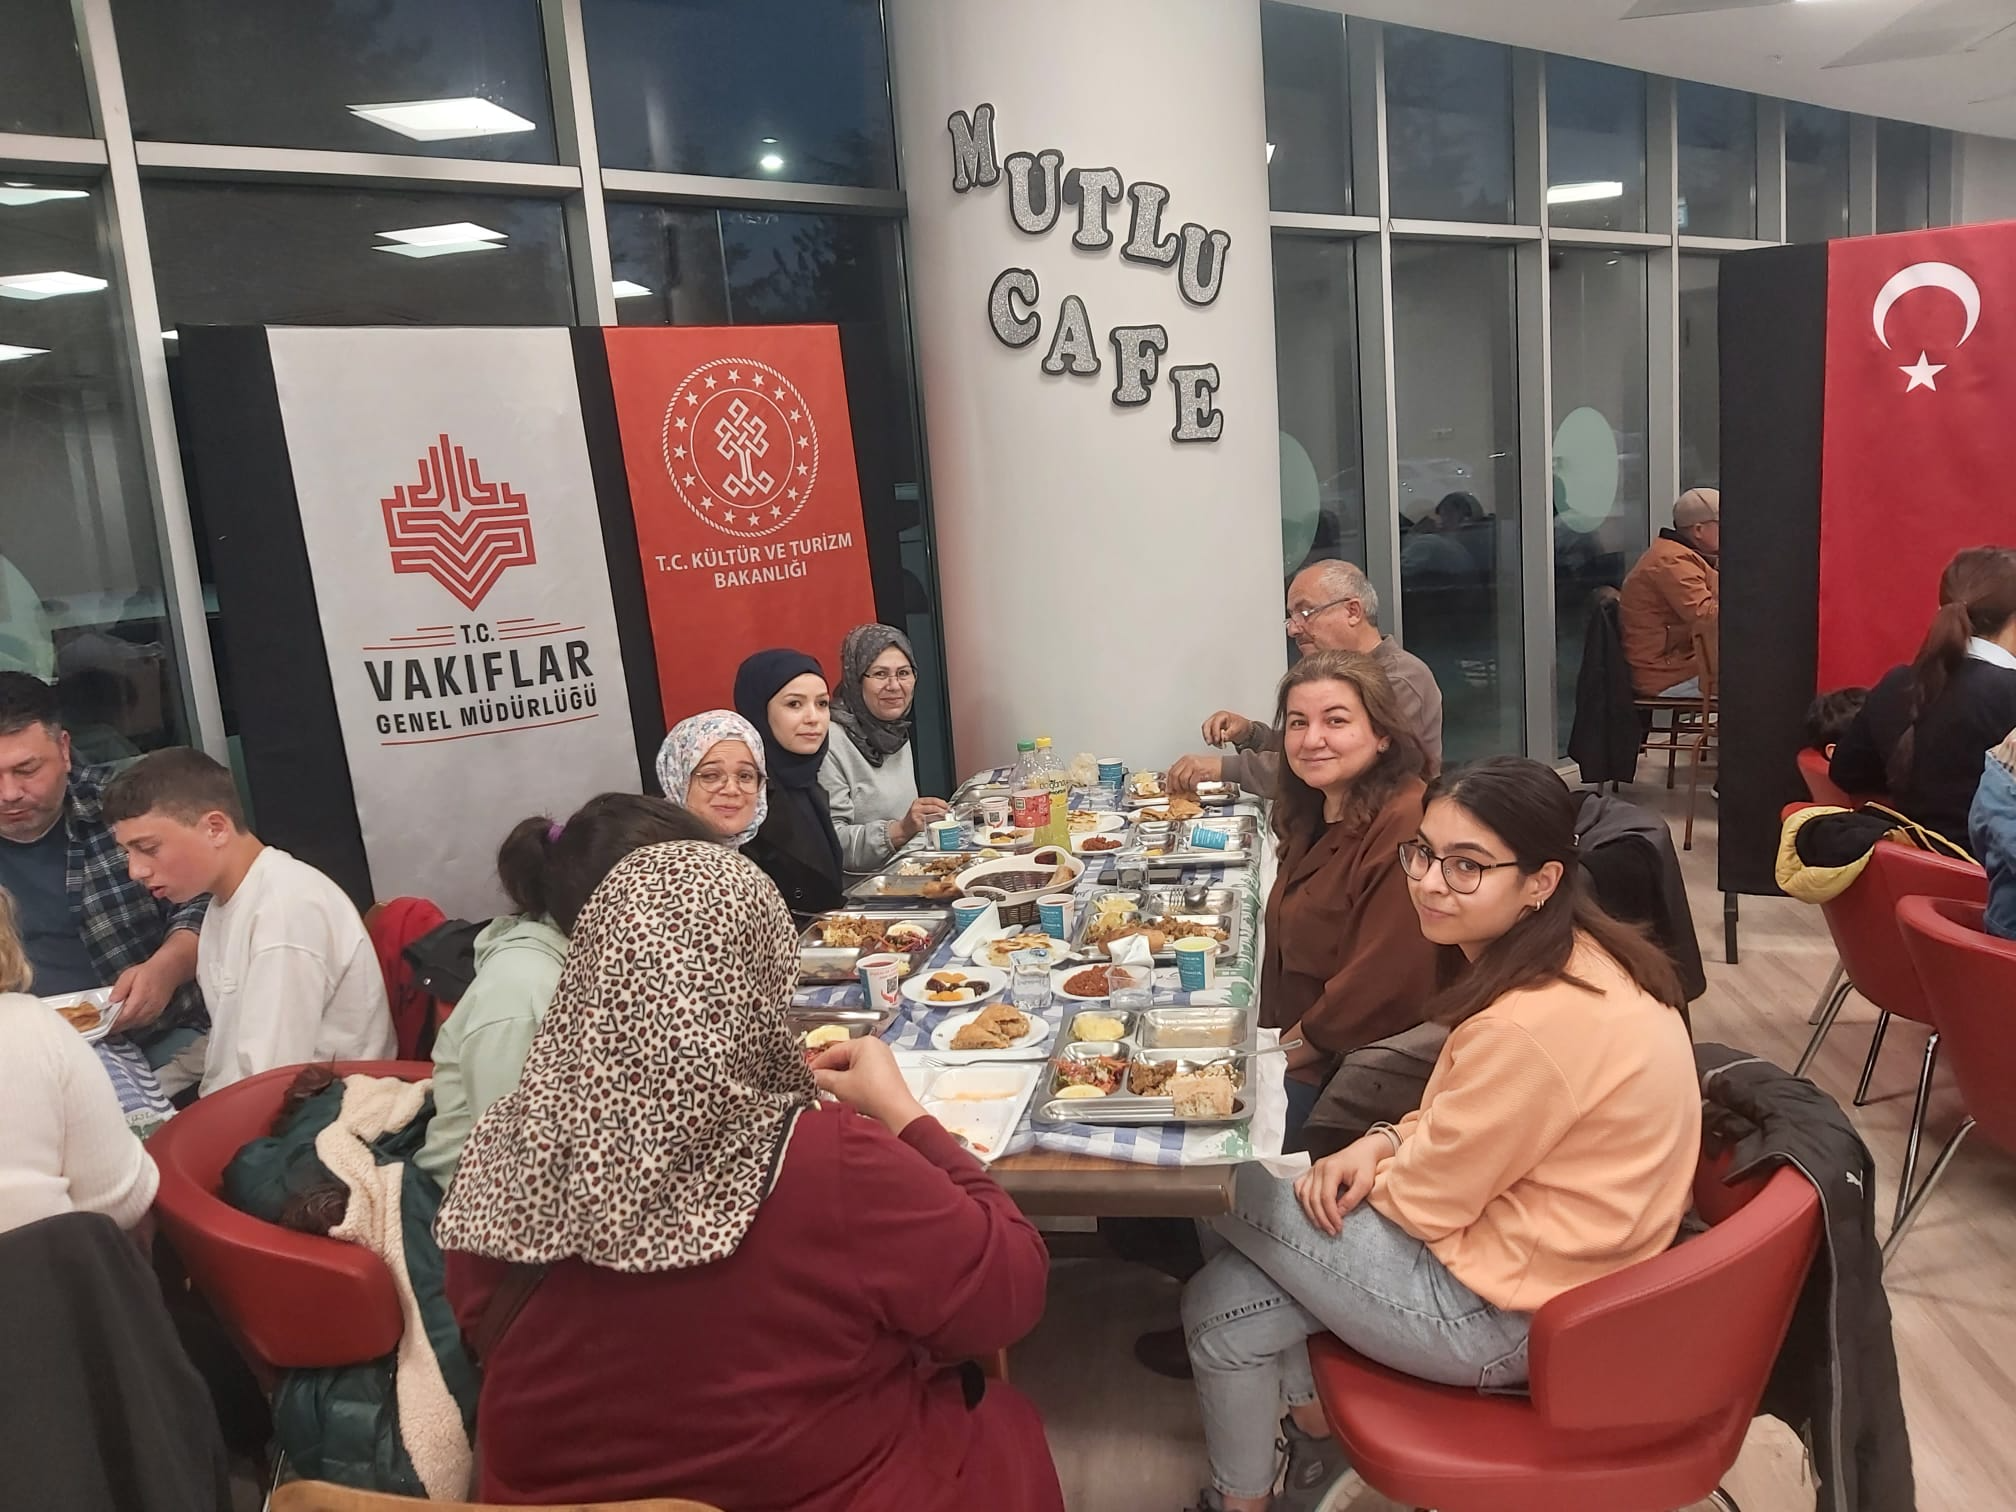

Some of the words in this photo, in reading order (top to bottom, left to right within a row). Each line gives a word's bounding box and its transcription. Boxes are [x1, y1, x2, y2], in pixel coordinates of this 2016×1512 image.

[948, 103, 1231, 306] MUTLU
[988, 268, 1223, 442] CAFE
[655, 554, 688, 572] T.C.
[692, 543, 761, 569] KÜLTÜR
[764, 543, 786, 560] VE
[789, 532, 853, 555] TURİZM
[714, 559, 808, 589] BAKANLIĞI
[460, 623, 495, 644] T.C.
[364, 640, 594, 702] VAKIFLAR
[376, 710, 452, 735] GENEL
[460, 682, 597, 727] MÜDÜRLÜĞÜ
